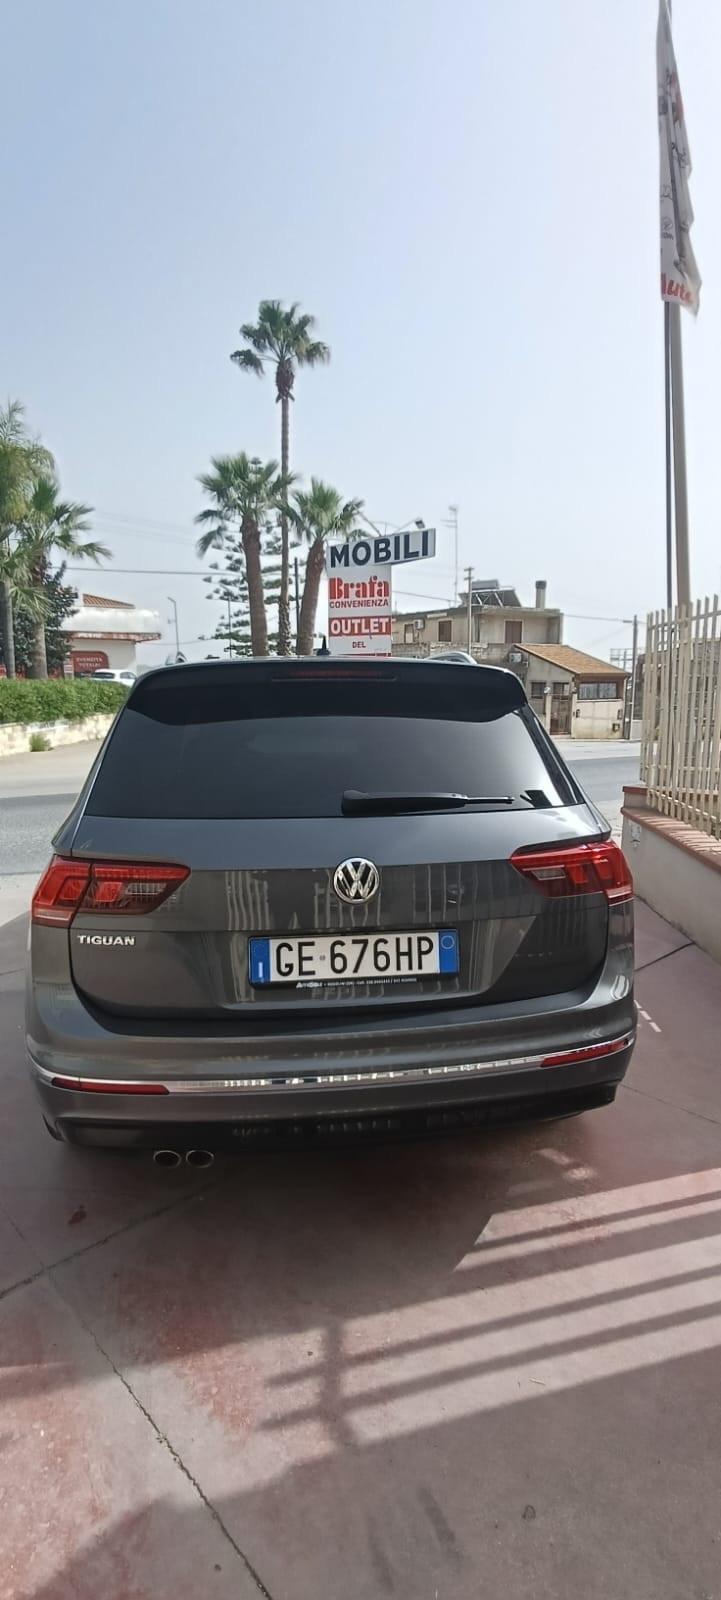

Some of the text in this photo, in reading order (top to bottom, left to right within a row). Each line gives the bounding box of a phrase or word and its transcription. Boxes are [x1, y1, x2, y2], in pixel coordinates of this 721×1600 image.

[330, 531, 429, 568] MOBILI
[329, 575, 389, 599] Brafa
[329, 599, 389, 609] CONVENIENZA
[330, 618, 388, 635] OUTLET
[352, 641, 367, 649] DEL
[77, 935, 135, 946] TIGUAN
[275, 936, 434, 977] GE 676HP
